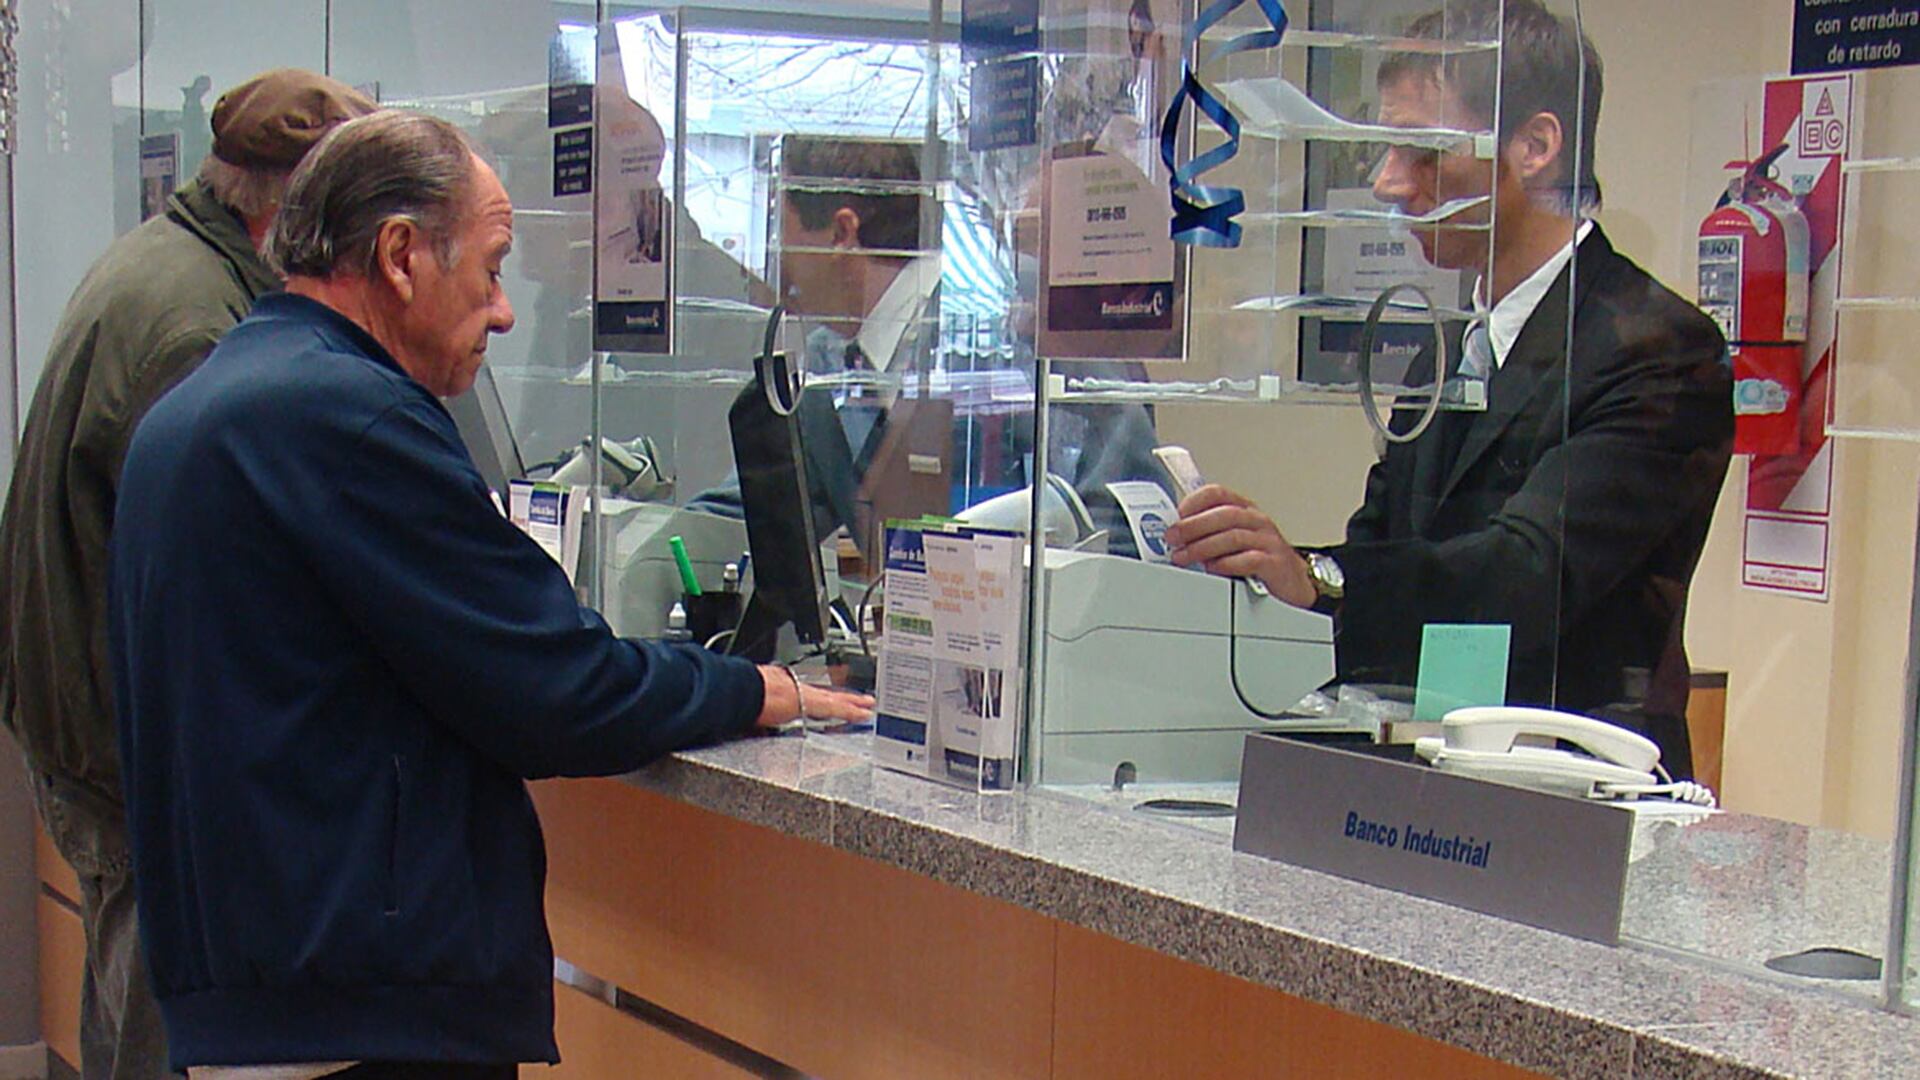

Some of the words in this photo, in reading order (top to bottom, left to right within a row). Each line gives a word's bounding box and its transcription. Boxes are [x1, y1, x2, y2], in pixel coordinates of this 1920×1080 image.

[1814, 19, 1841, 36] con
[1850, 7, 1919, 32] cerradura
[1827, 44, 1845, 64] de
[1849, 38, 1901, 62] retardo
[1343, 810, 1398, 848] Banco
[1402, 823, 1492, 869] Industrial
